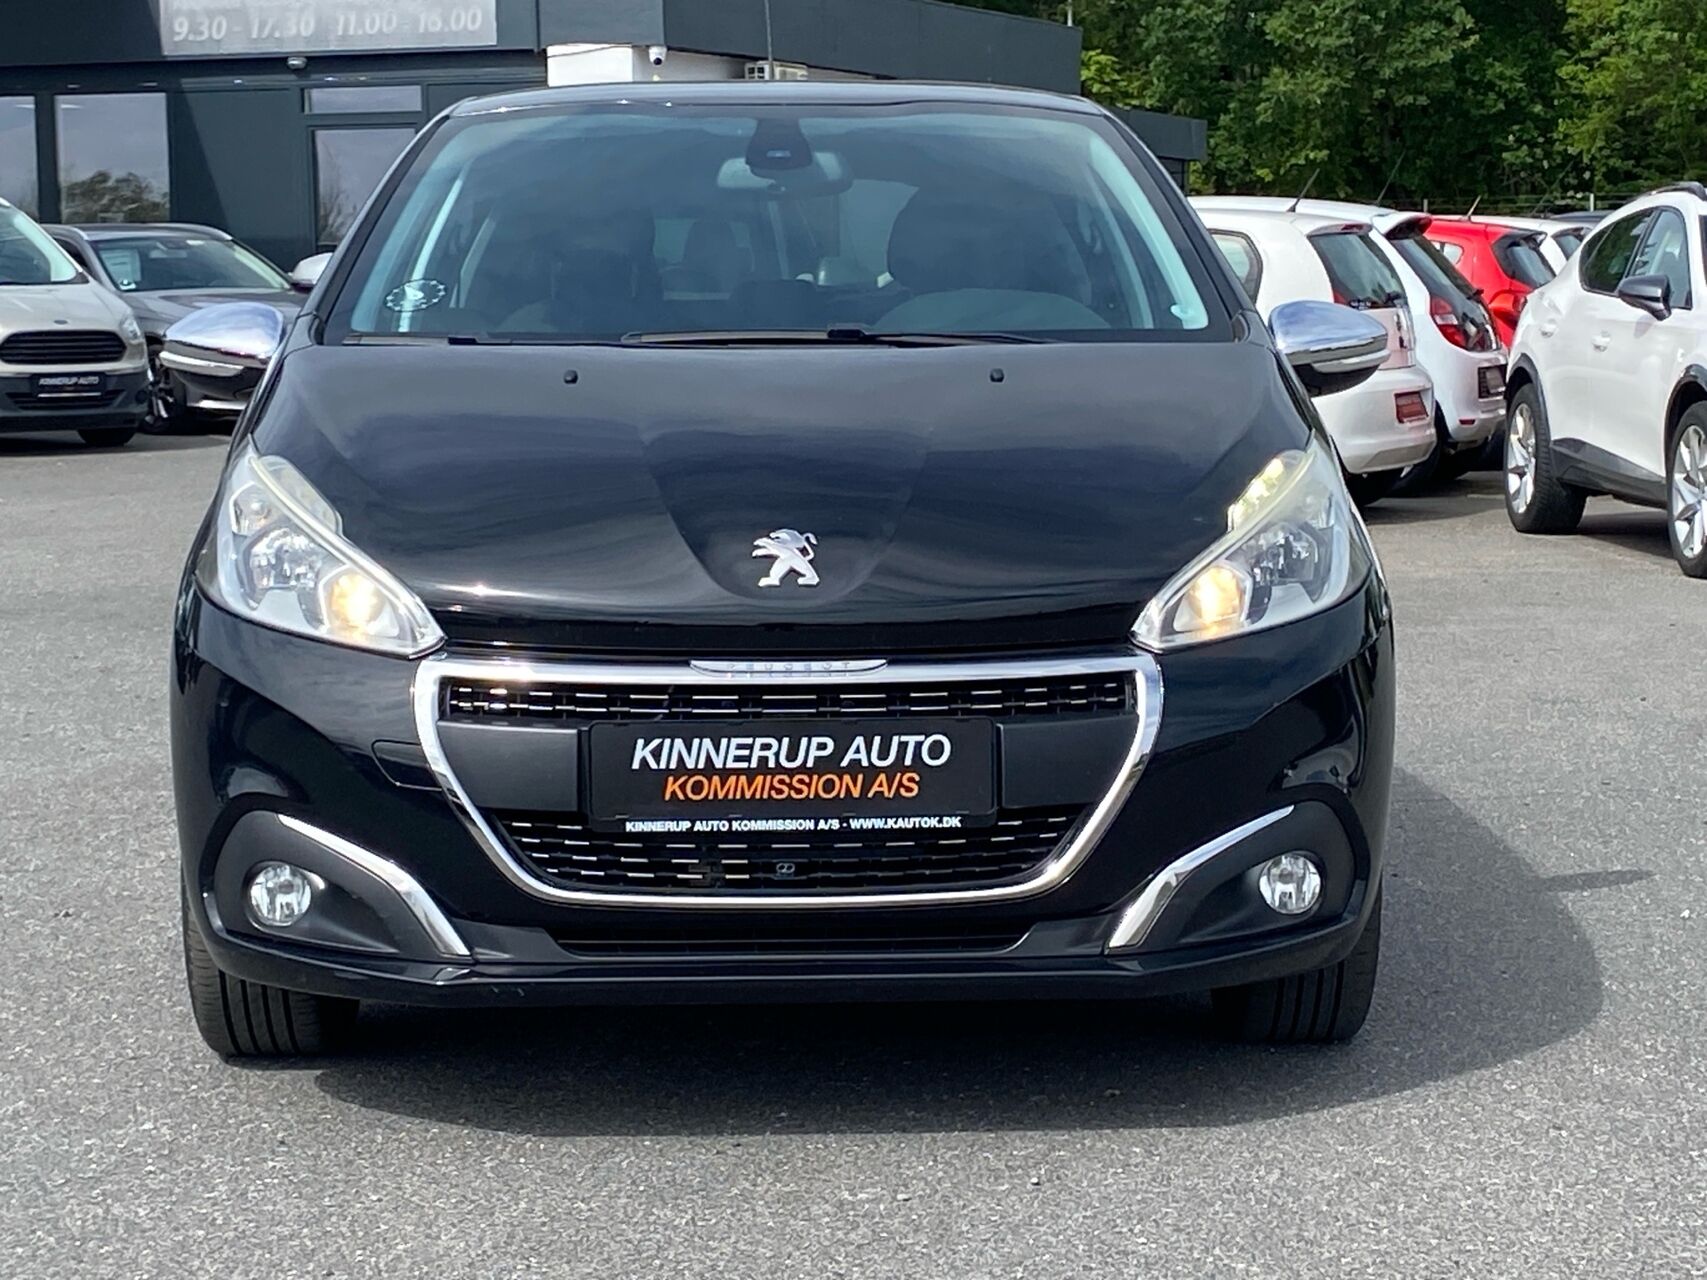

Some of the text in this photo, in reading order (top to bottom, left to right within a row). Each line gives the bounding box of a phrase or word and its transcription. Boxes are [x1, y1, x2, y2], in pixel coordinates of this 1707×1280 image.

[173, 15, 227, 41] 9.30
[250, 14, 316, 39] 17.30
[336, 10, 397, 36] 11.00
[418, 7, 483, 33] 16.00
[727, 661, 851, 671] PEUGEOT
[631, 733, 952, 770] KINNERUP AUTO
[664, 771, 921, 801] KOMMISSION A/S
[625, 820, 692, 833] KINNERUP
[693, 819, 730, 832] AUTO
[731, 819, 815, 832] KOMMISSION
[817, 818, 840, 831] A/S
[849, 815, 963, 830] WWW.KAUTOK.DK
